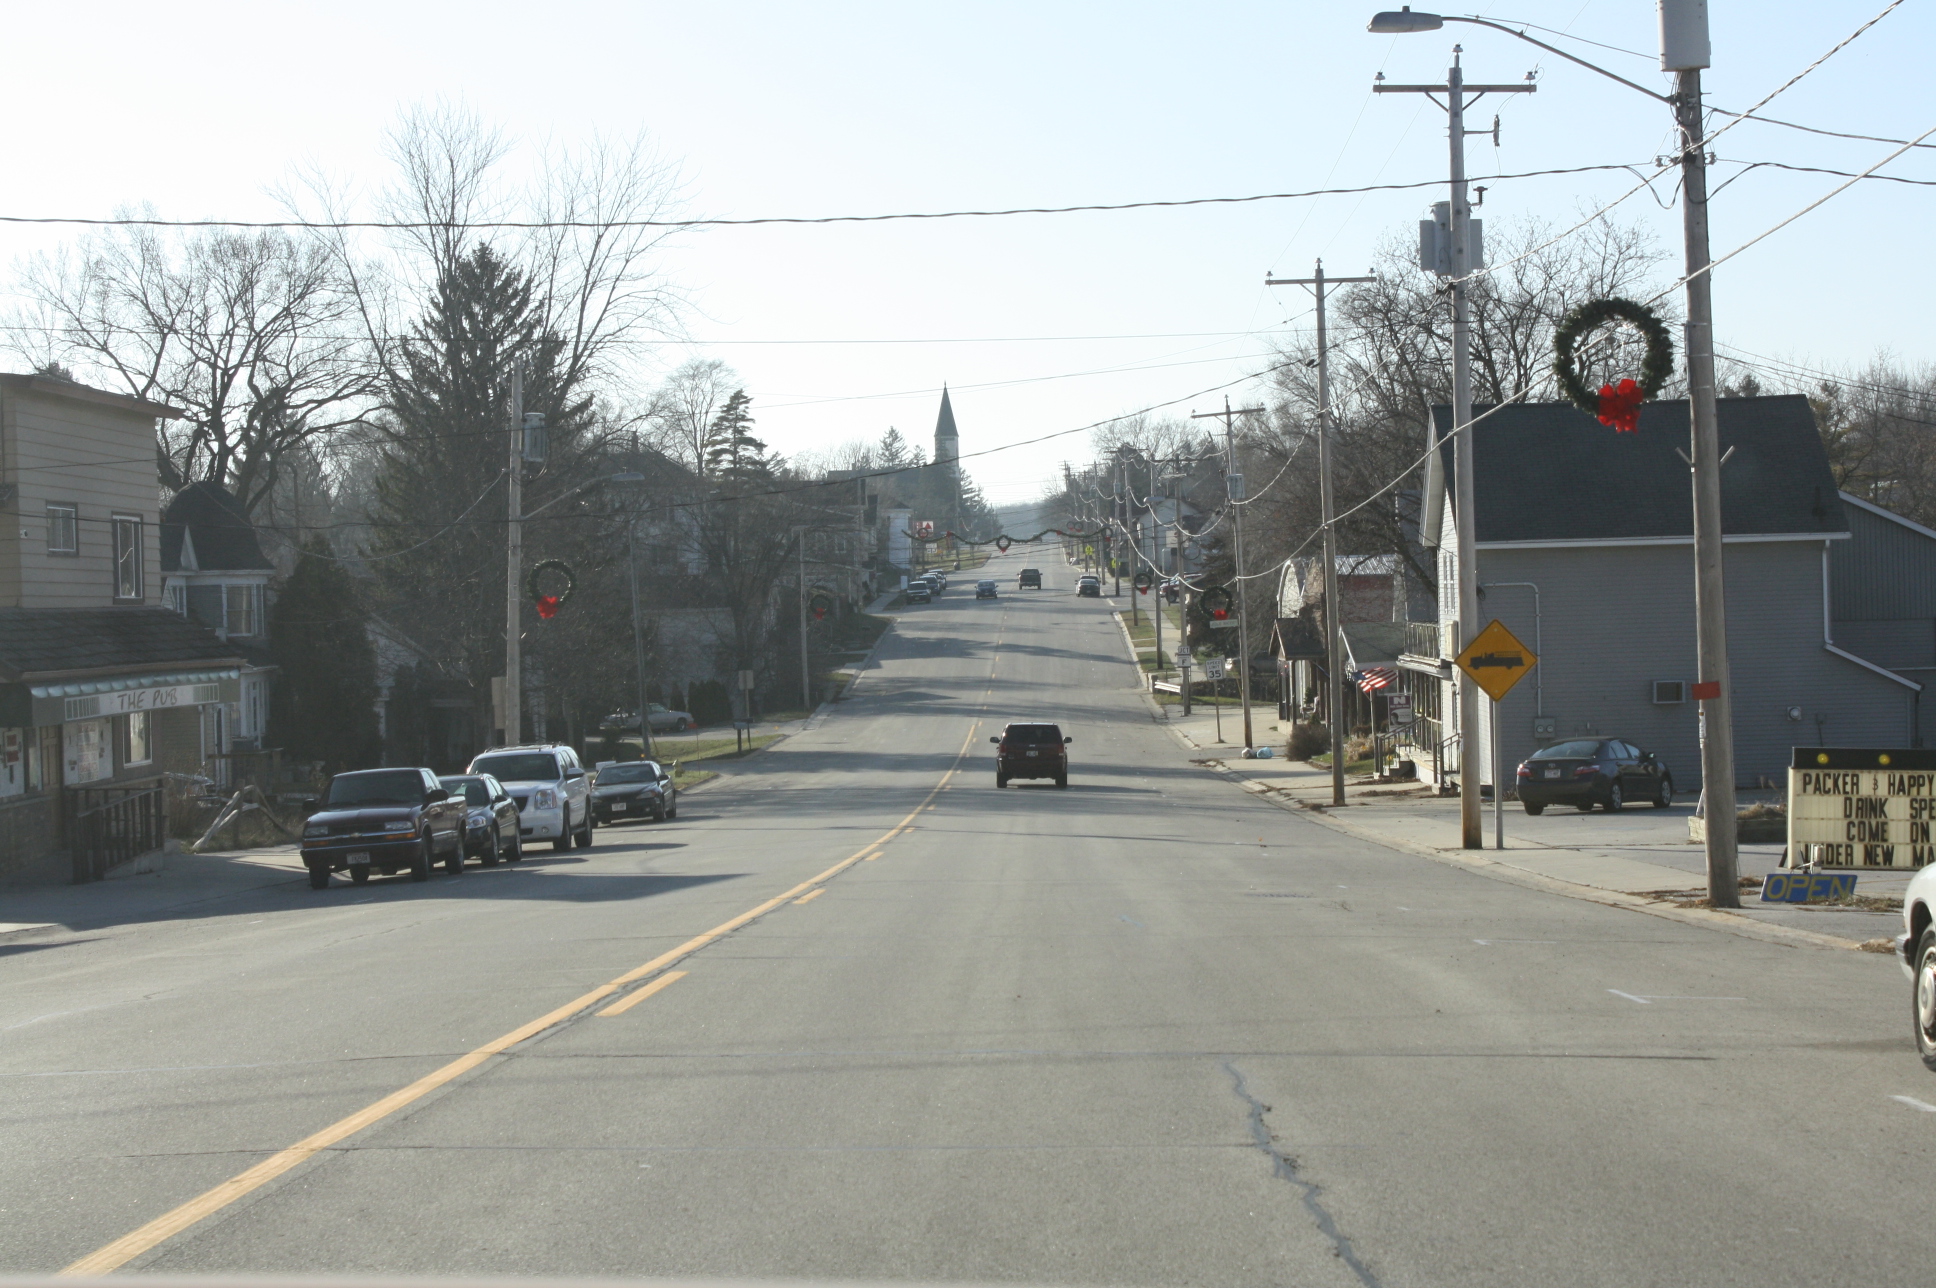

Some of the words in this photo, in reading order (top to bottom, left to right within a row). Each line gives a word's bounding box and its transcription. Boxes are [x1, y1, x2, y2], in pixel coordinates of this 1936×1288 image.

[1209, 670, 1222, 678] 35
[117, 691, 146, 711] THE
[153, 688, 178, 707] PUB
[1802, 773, 1860, 794] PACKER
[1887, 774, 1934, 796] HAPPY
[1843, 797, 1889, 819] DRINK
[1846, 821, 1889, 843] COME
[1909, 822, 1930, 843] ON
[1804, 843, 1854, 866] UDER
[1863, 844, 1894, 866] NEW
[1766, 875, 1853, 900] OPEN
